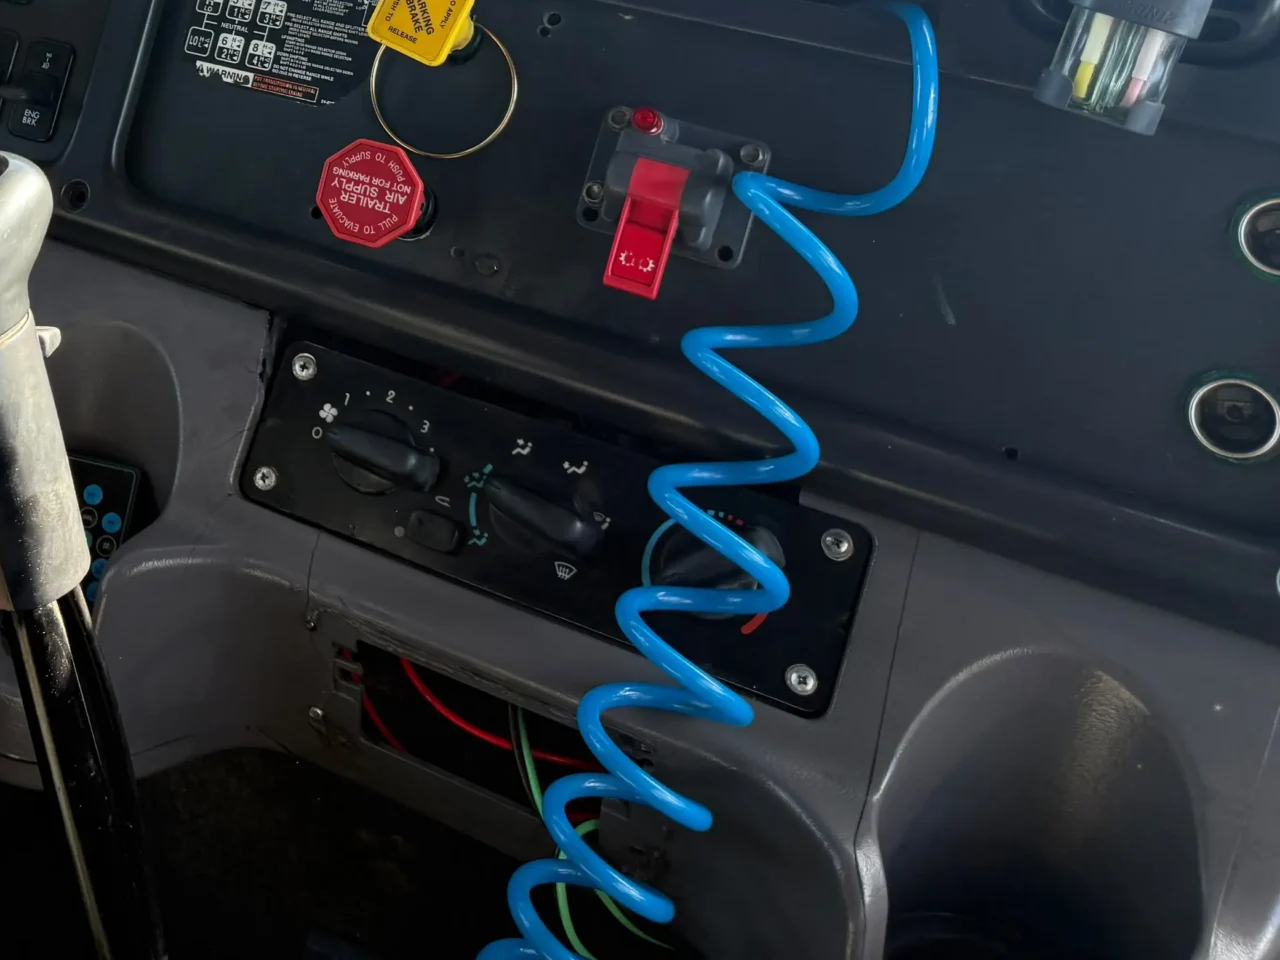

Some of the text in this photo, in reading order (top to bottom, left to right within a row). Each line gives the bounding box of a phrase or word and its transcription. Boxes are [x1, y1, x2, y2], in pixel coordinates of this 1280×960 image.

[263, 1, 272, 10] 7
[233, 8, 238, 17] 1
[385, 12, 394, 22] TO
[439, 7, 453, 29] APPLY
[263, 14, 270, 23] 3
[220, 22, 249, 33] NEUTRAL
[388, 25, 418, 44] RELEASE
[221, 36, 229, 45] 6
[252, 43, 259, 52] 8
[221, 49, 228, 58] 2
[252, 56, 258, 66] 4
[24, 109, 40, 119] ENG
[22, 116, 37, 126] BRK
[342, 151, 406, 182] PUSH TO SUPPLY
[333, 166, 411, 194] NOT FOR PARKING
[331, 177, 407, 205] AIR SUPPLY
[340, 190, 391, 214] TRAILER
[328, 197, 399, 234] PULL TO EVACUATE
[344, 392, 350, 406] 1
[386, 390, 396, 403] 2
[420, 420, 430, 433] 3
